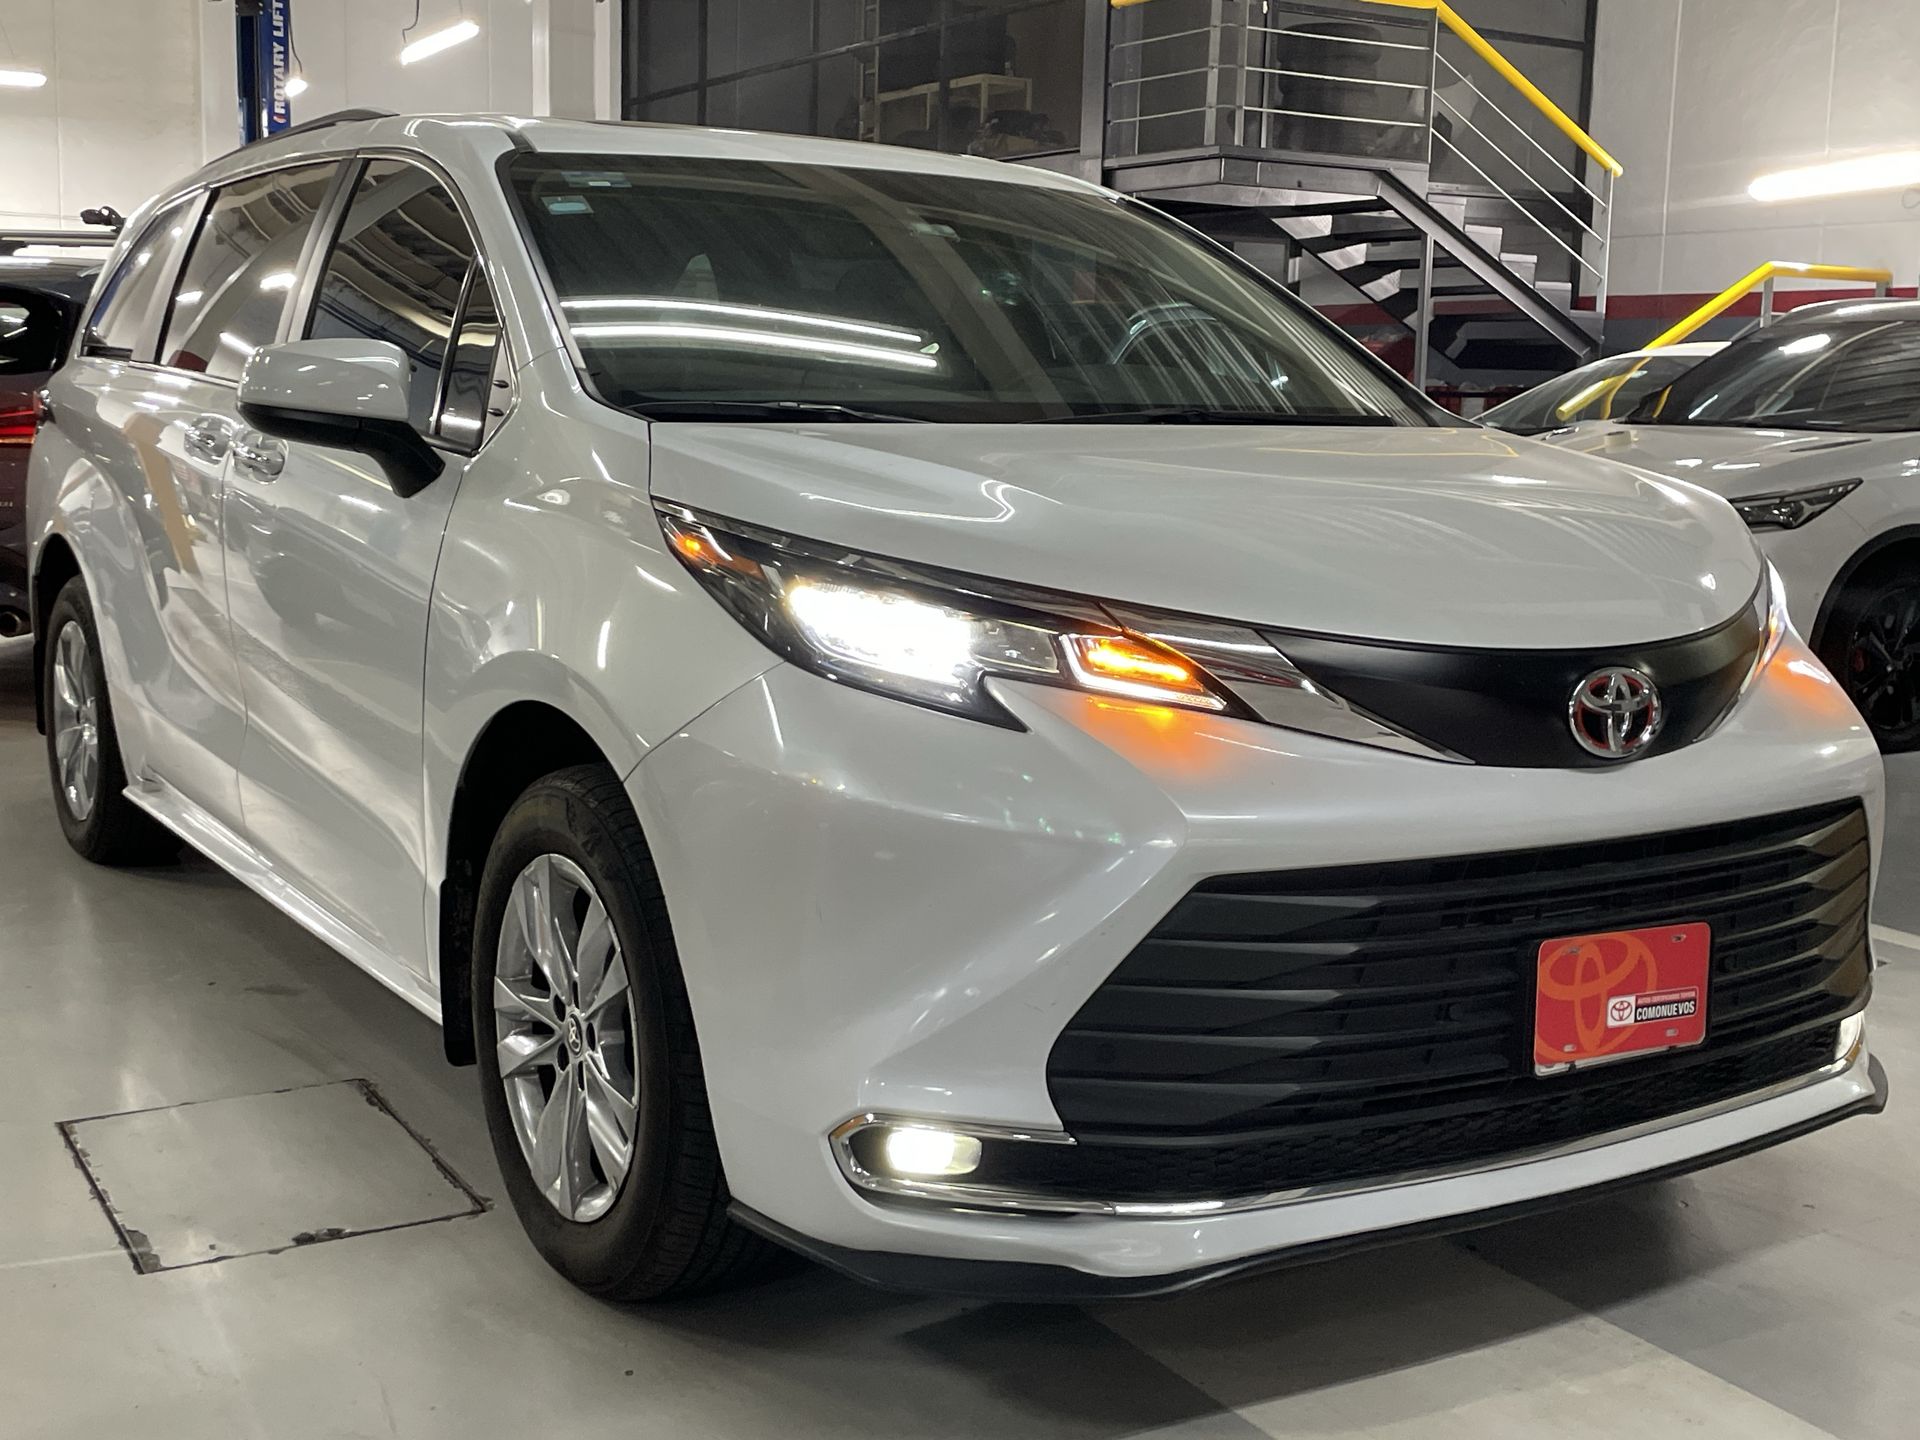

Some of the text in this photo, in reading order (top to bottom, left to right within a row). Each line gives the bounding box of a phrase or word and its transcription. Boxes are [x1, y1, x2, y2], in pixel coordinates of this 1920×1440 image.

[272, 0, 286, 114] ROTARY LIFT
[1636, 1001, 1695, 1021] COMONUEVOS
